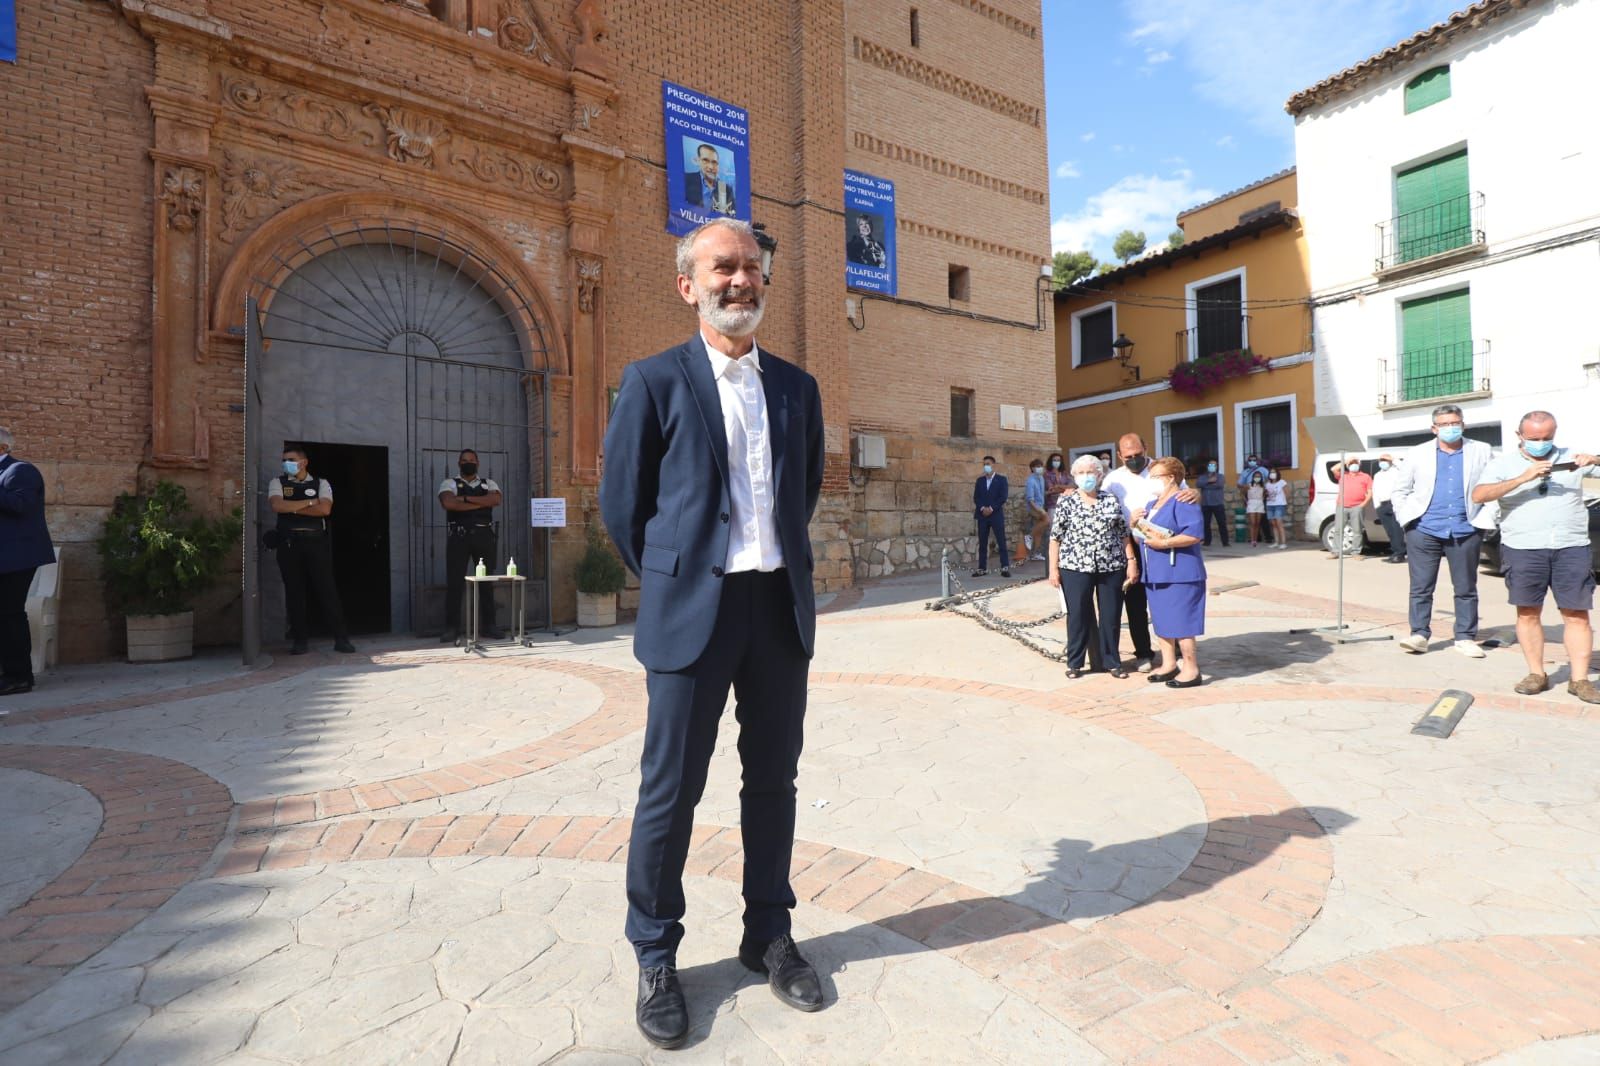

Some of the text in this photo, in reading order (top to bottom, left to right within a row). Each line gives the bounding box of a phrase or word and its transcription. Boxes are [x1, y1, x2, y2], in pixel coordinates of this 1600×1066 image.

[666, 101, 747, 135] PREMIO TREVILLANO
[667, 87, 745, 121] PREGONERO 2018
[669, 116, 745, 147] PACO ORTIZ REMACHA
[857, 187, 893, 202] TREVILLANO
[877, 181, 892, 191] 2019
